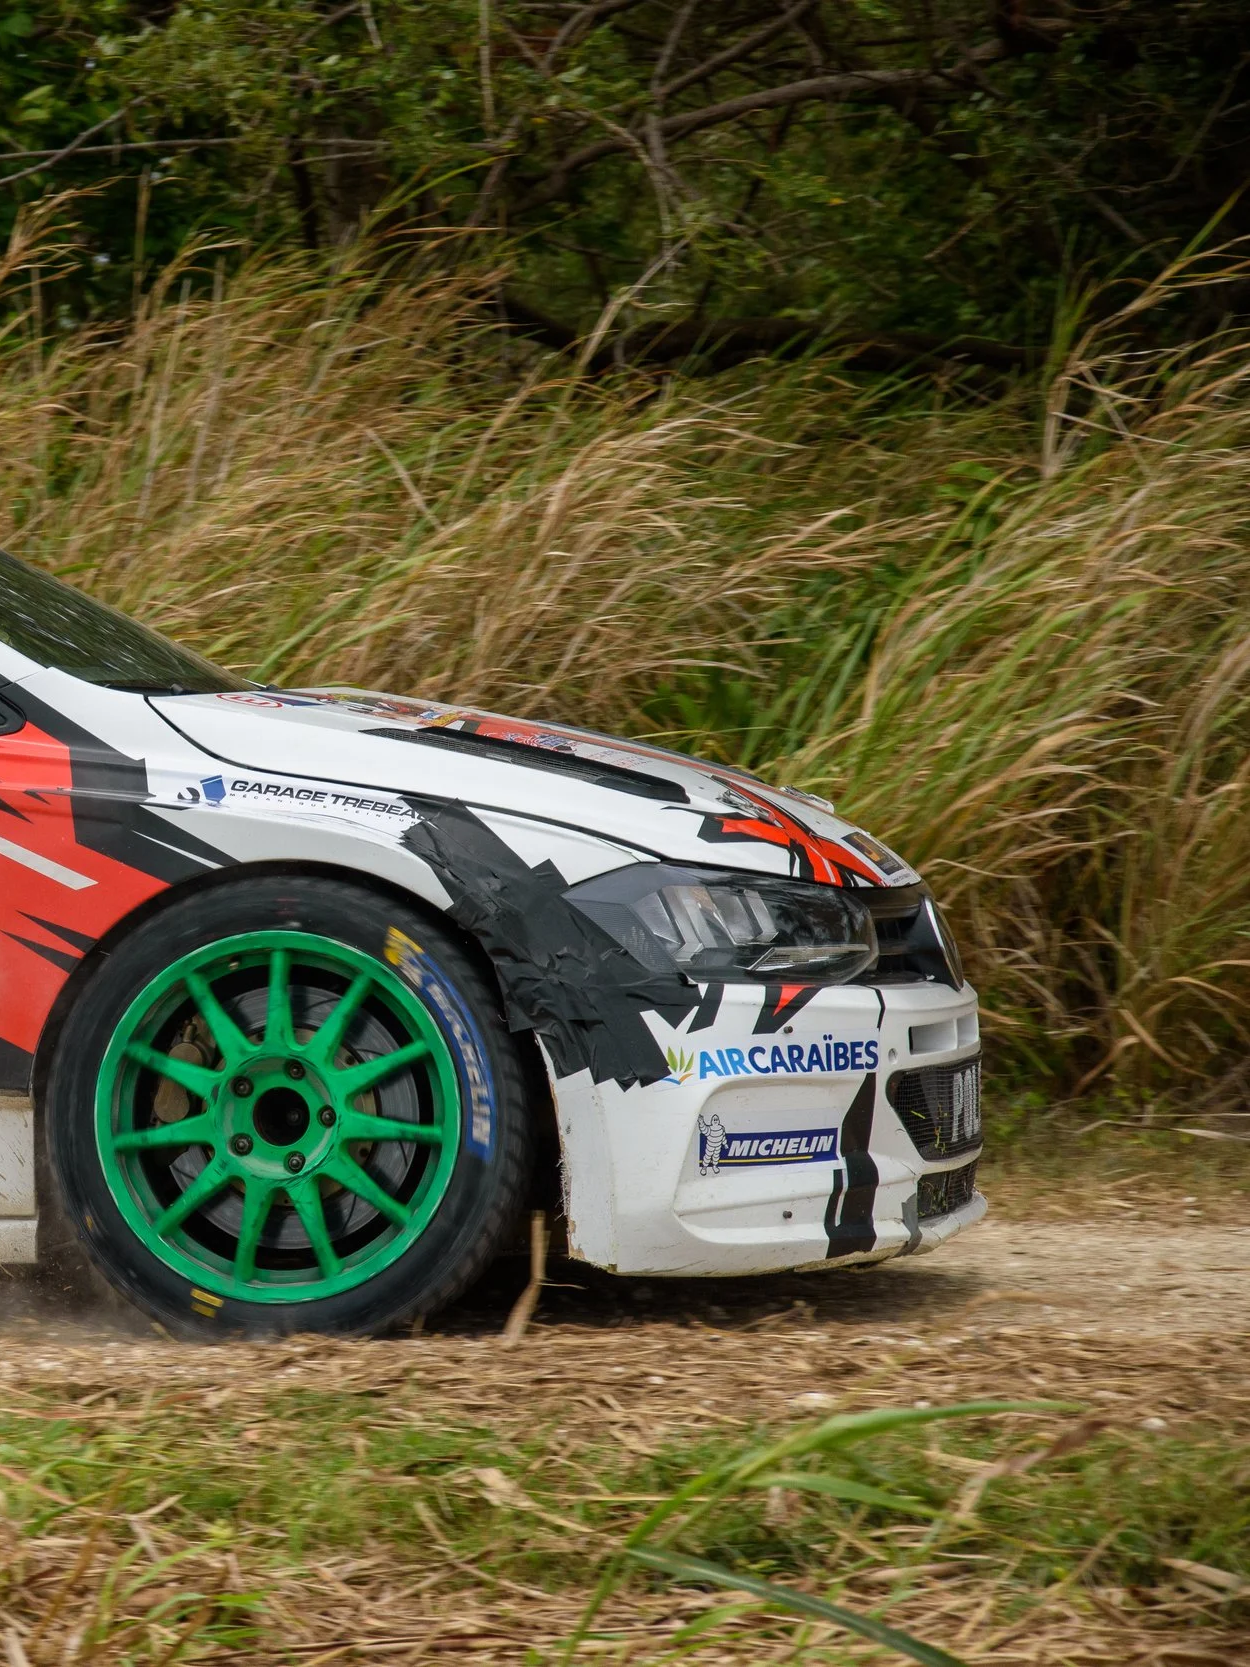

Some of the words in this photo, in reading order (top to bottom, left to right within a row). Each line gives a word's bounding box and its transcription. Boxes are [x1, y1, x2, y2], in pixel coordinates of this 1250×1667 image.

[230, 780, 328, 804] GARAGE
[331, 793, 426, 821] TREBEA
[728, 1135, 835, 1157] MICHELIN
